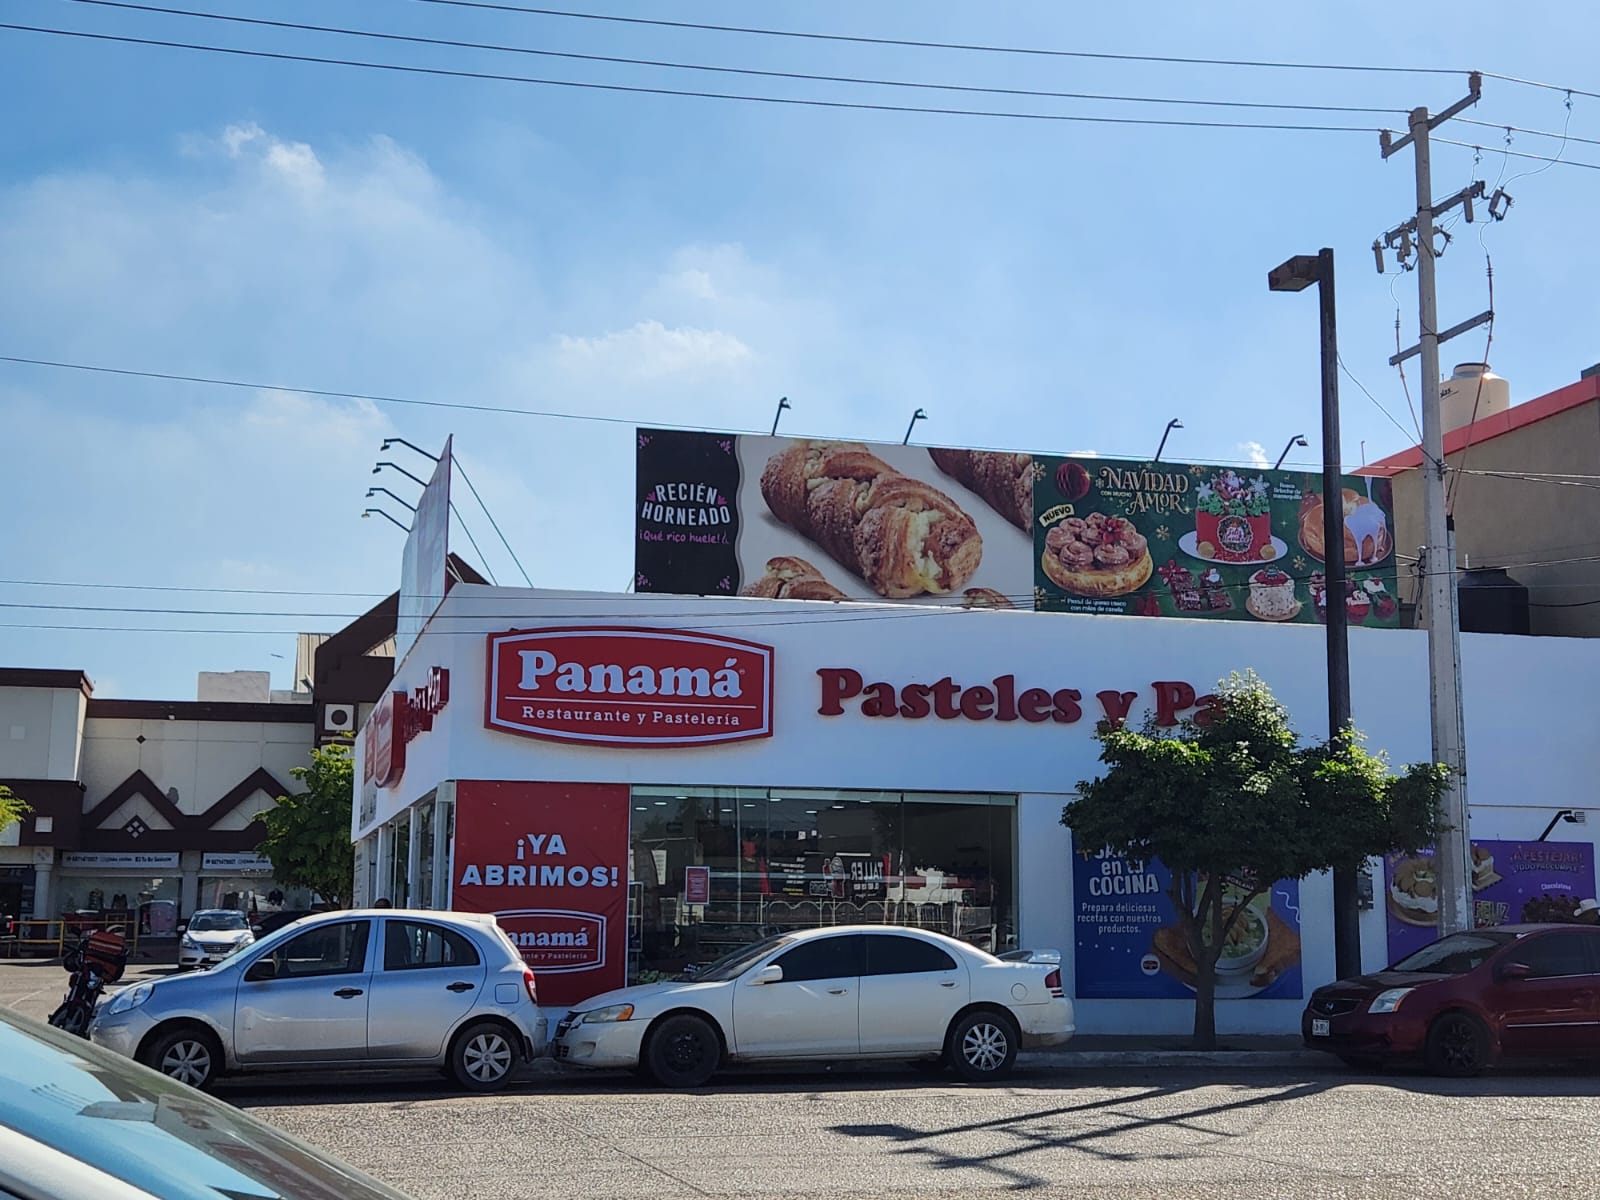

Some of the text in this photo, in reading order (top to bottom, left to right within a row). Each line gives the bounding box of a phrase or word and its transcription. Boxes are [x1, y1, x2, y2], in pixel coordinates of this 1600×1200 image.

[1100, 466, 1189, 494] NAVIDAD
[655, 483, 718, 505] RECIÉN
[1125, 492, 1190, 515] AMOR
[641, 501, 731, 526] HORNEADO
[1042, 506, 1072, 523] NUEVO
[639, 530, 664, 542] ¡Qué
[666, 531, 687, 542] rico
[517, 649, 743, 698] Panamá
[815, 667, 1083, 723] Pasteles
[1095, 689, 1138, 731] y
[522, 706, 740, 726] Restaurante y Pastelería
[516, 833, 567, 860] ¡YA
[459, 864, 619, 888] ABRIMOS!
[1101, 860, 1122, 876] en
[1089, 873, 1160, 897] COCINA
[1077, 913, 1162, 923] recetas con nuestros
[1081, 902, 1157, 914] Prepara deliciosas
[507, 927, 589, 947] anamá
[1098, 923, 1142, 935] productos.
